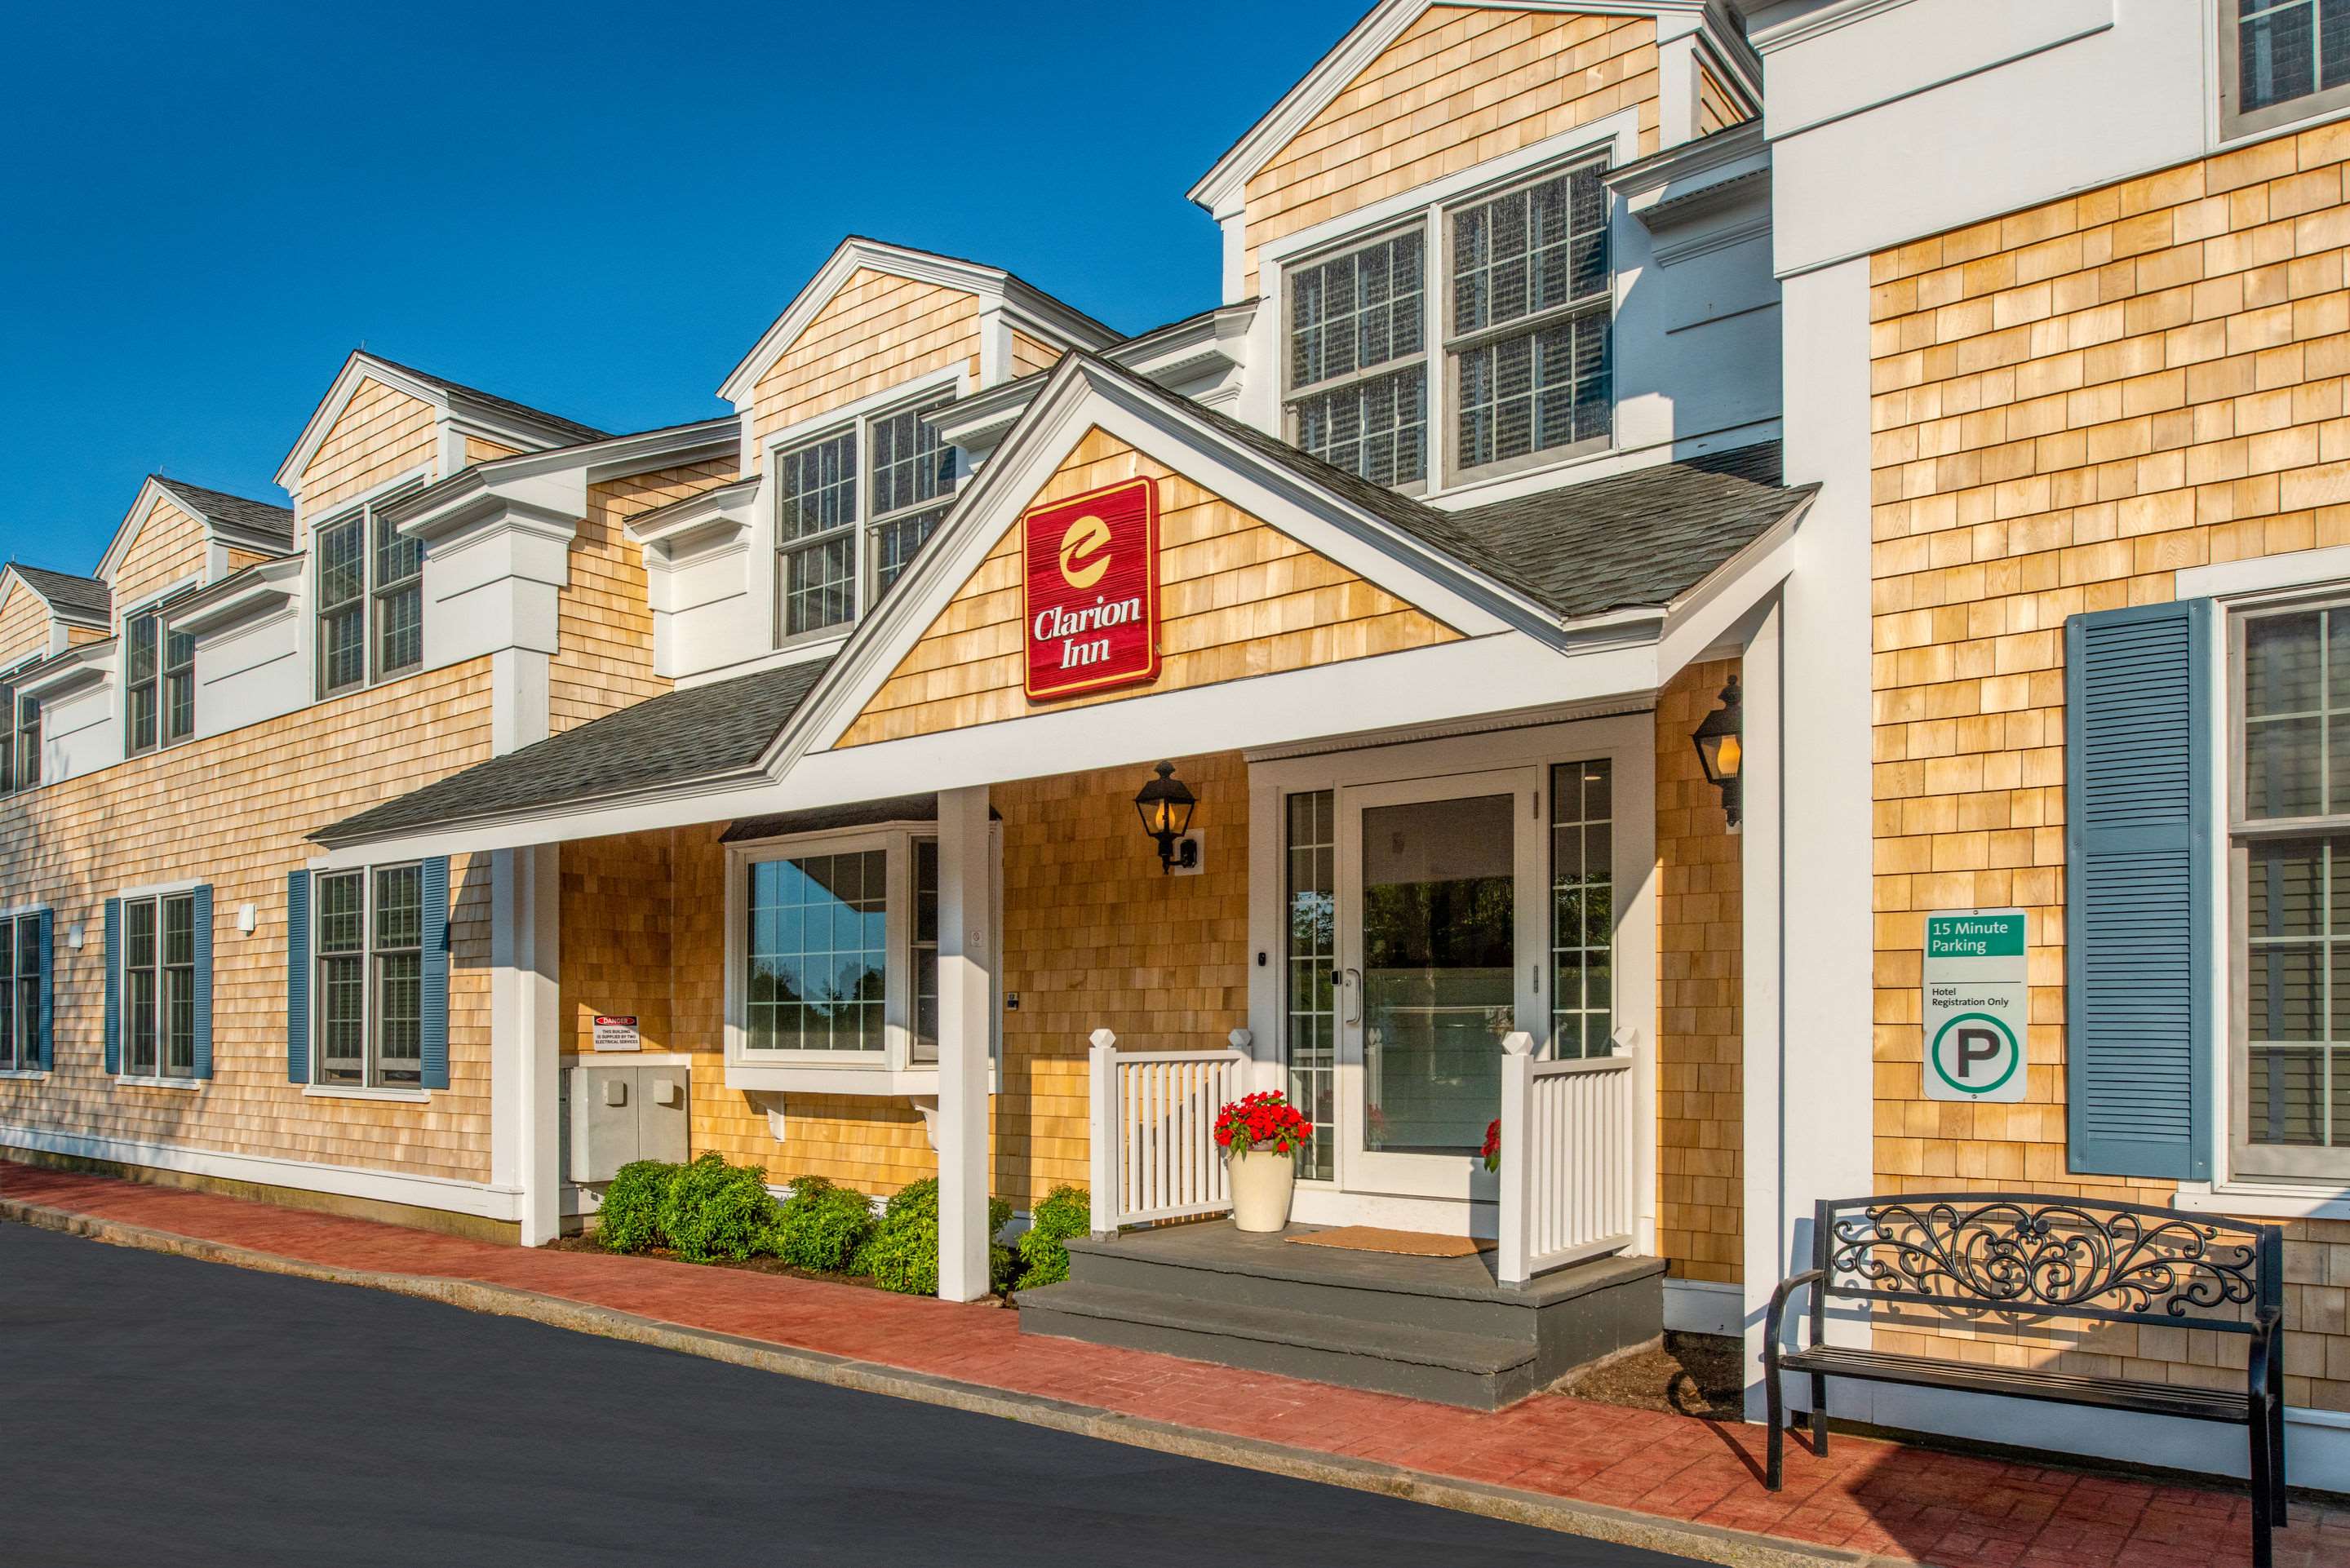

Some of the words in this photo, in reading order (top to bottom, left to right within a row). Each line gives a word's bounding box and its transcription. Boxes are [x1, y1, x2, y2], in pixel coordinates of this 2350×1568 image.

[1034, 596, 1141, 641] Clarion
[1059, 636, 1111, 669] Inn
[1933, 923, 1951, 935] 15
[1955, 922, 2008, 934] Minute
[1932, 939, 1987, 955] Parking
[1932, 998, 1985, 1008] Registration
[1988, 998, 2009, 1008] Only
[1958, 1029, 2000, 1078] P
